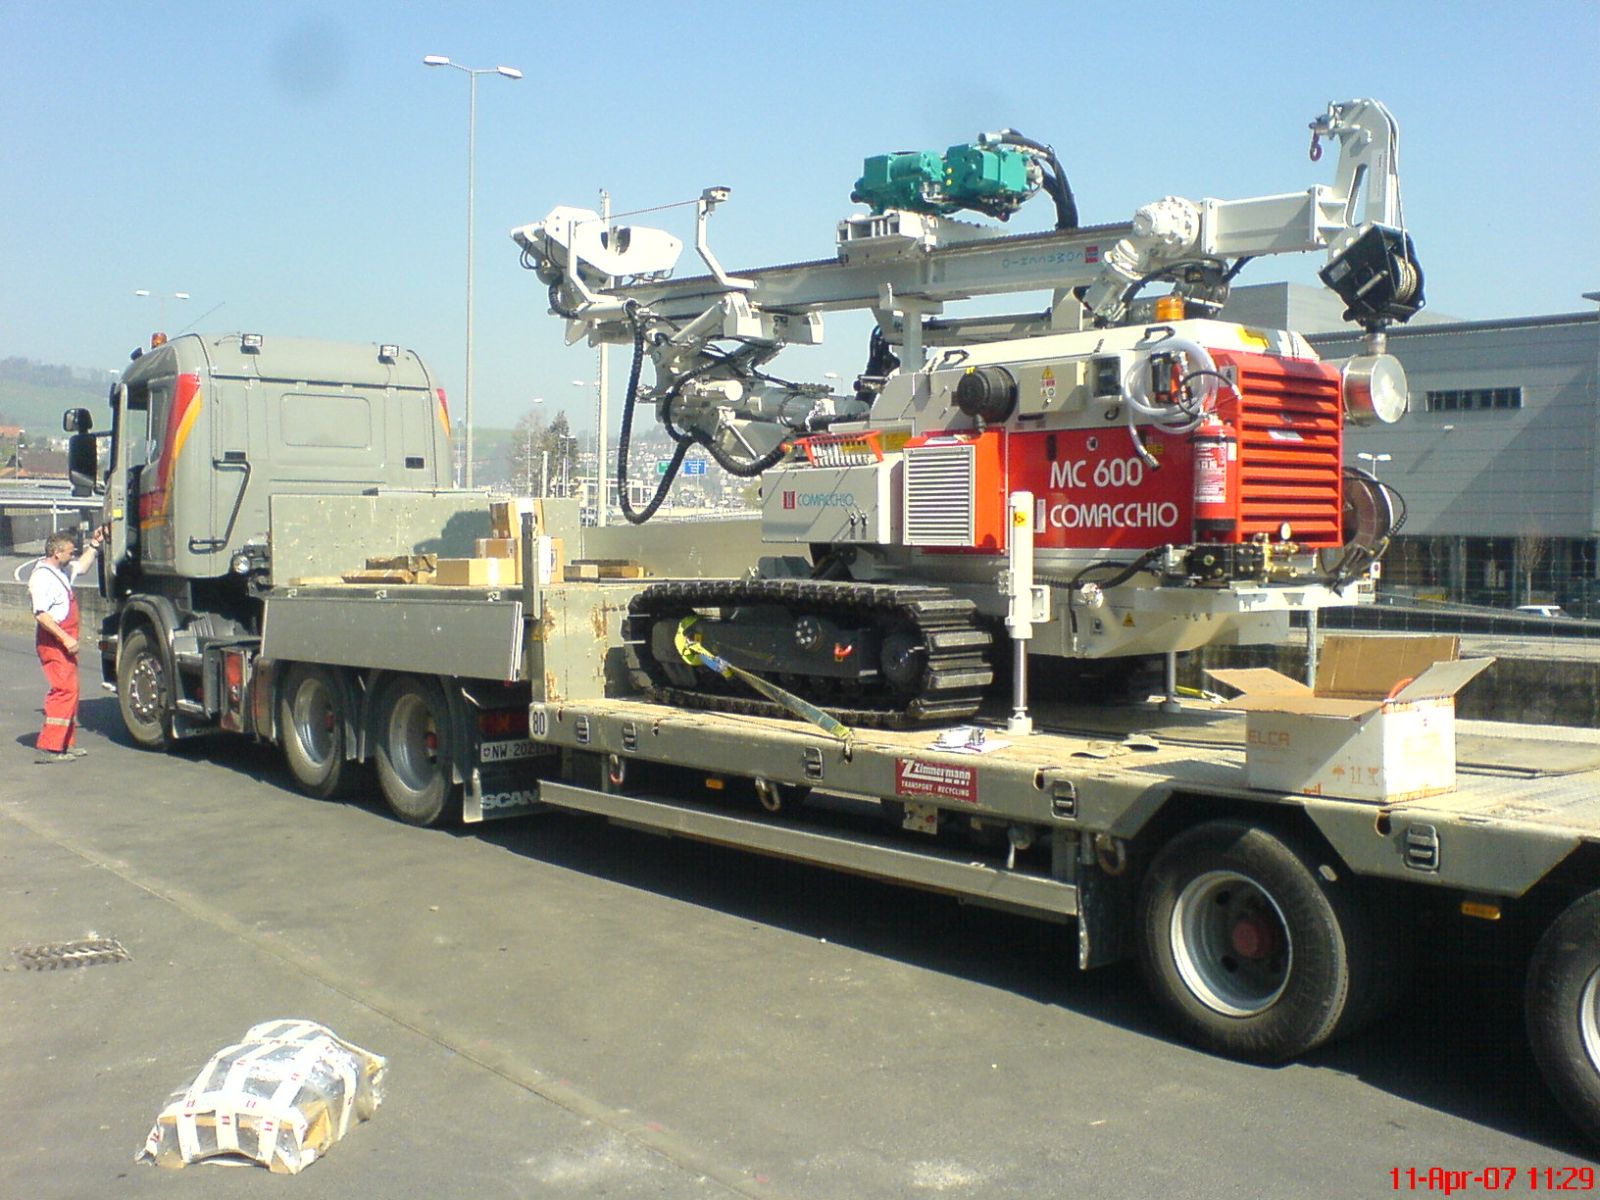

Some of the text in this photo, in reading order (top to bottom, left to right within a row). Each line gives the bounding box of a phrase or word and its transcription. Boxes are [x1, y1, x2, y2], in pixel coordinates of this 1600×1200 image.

[1050, 458, 1143, 488] MC 600
[797, 493, 854, 506] COMACCHIO
[1050, 502, 1178, 528] COMACCHIO
[533, 711, 545, 735] 80
[902, 780, 969, 797] TRANSPORT RECYCLING
[481, 790, 539, 809] SCAN
